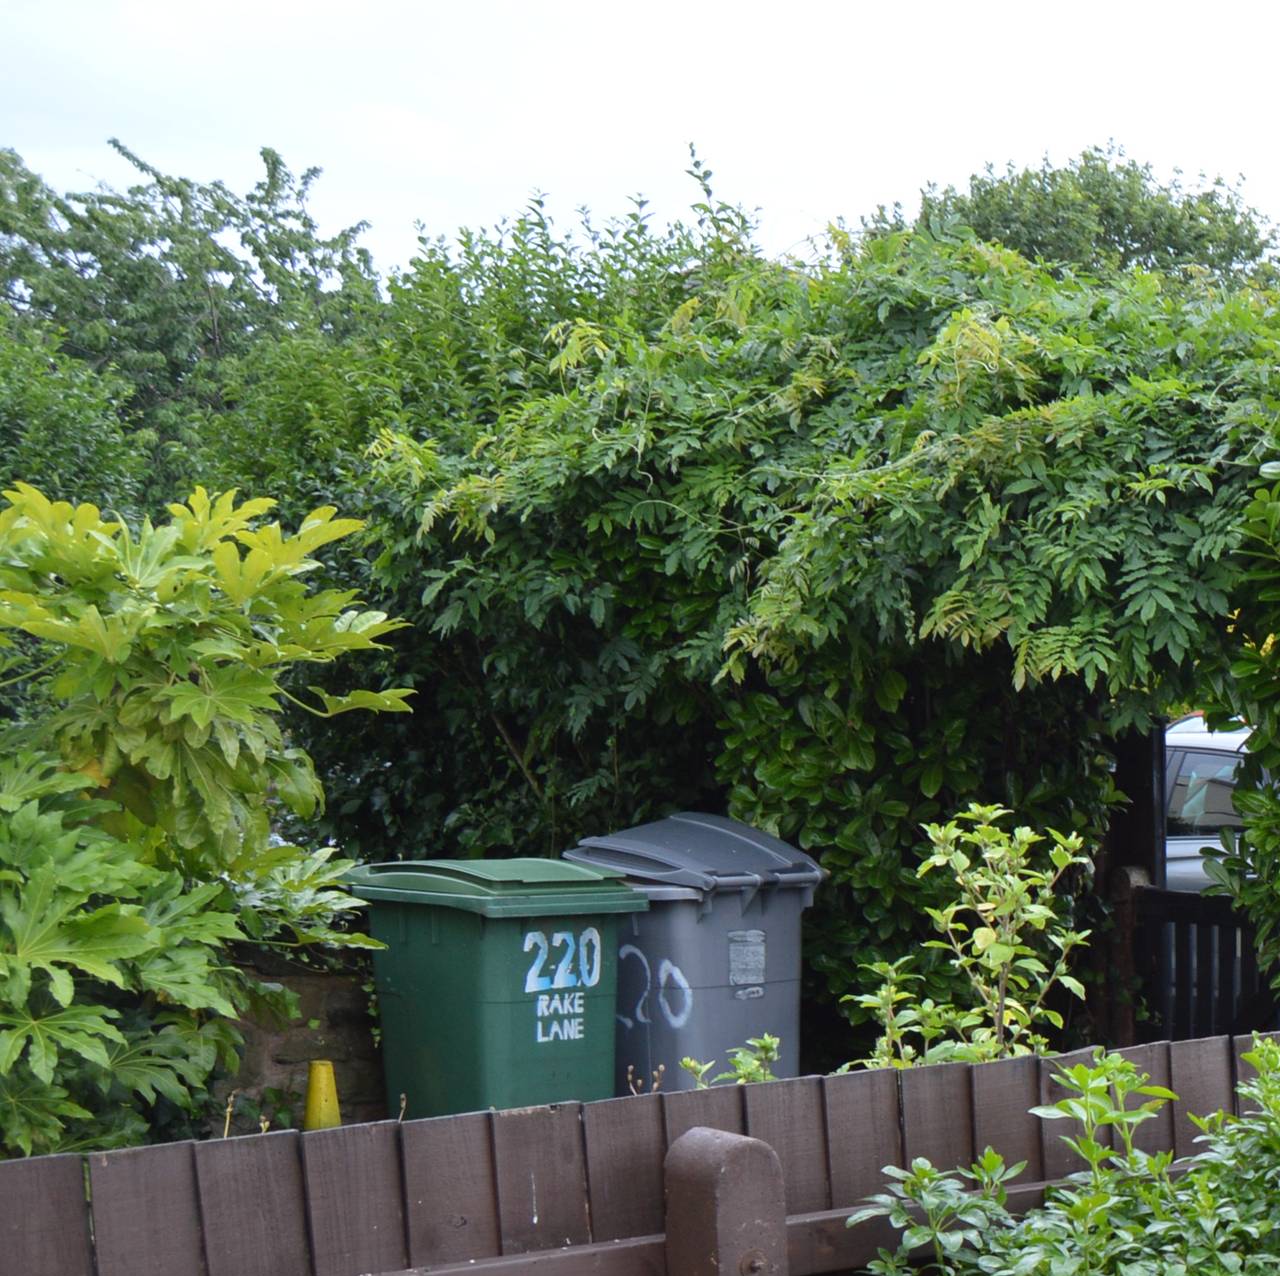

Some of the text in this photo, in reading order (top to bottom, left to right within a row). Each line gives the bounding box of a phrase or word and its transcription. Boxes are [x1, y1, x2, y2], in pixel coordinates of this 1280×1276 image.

[524, 926, 601, 993] 220
[537, 993, 585, 1016] RAKE
[616, 944, 693, 1029] 20
[537, 1017, 585, 1042] LANE
